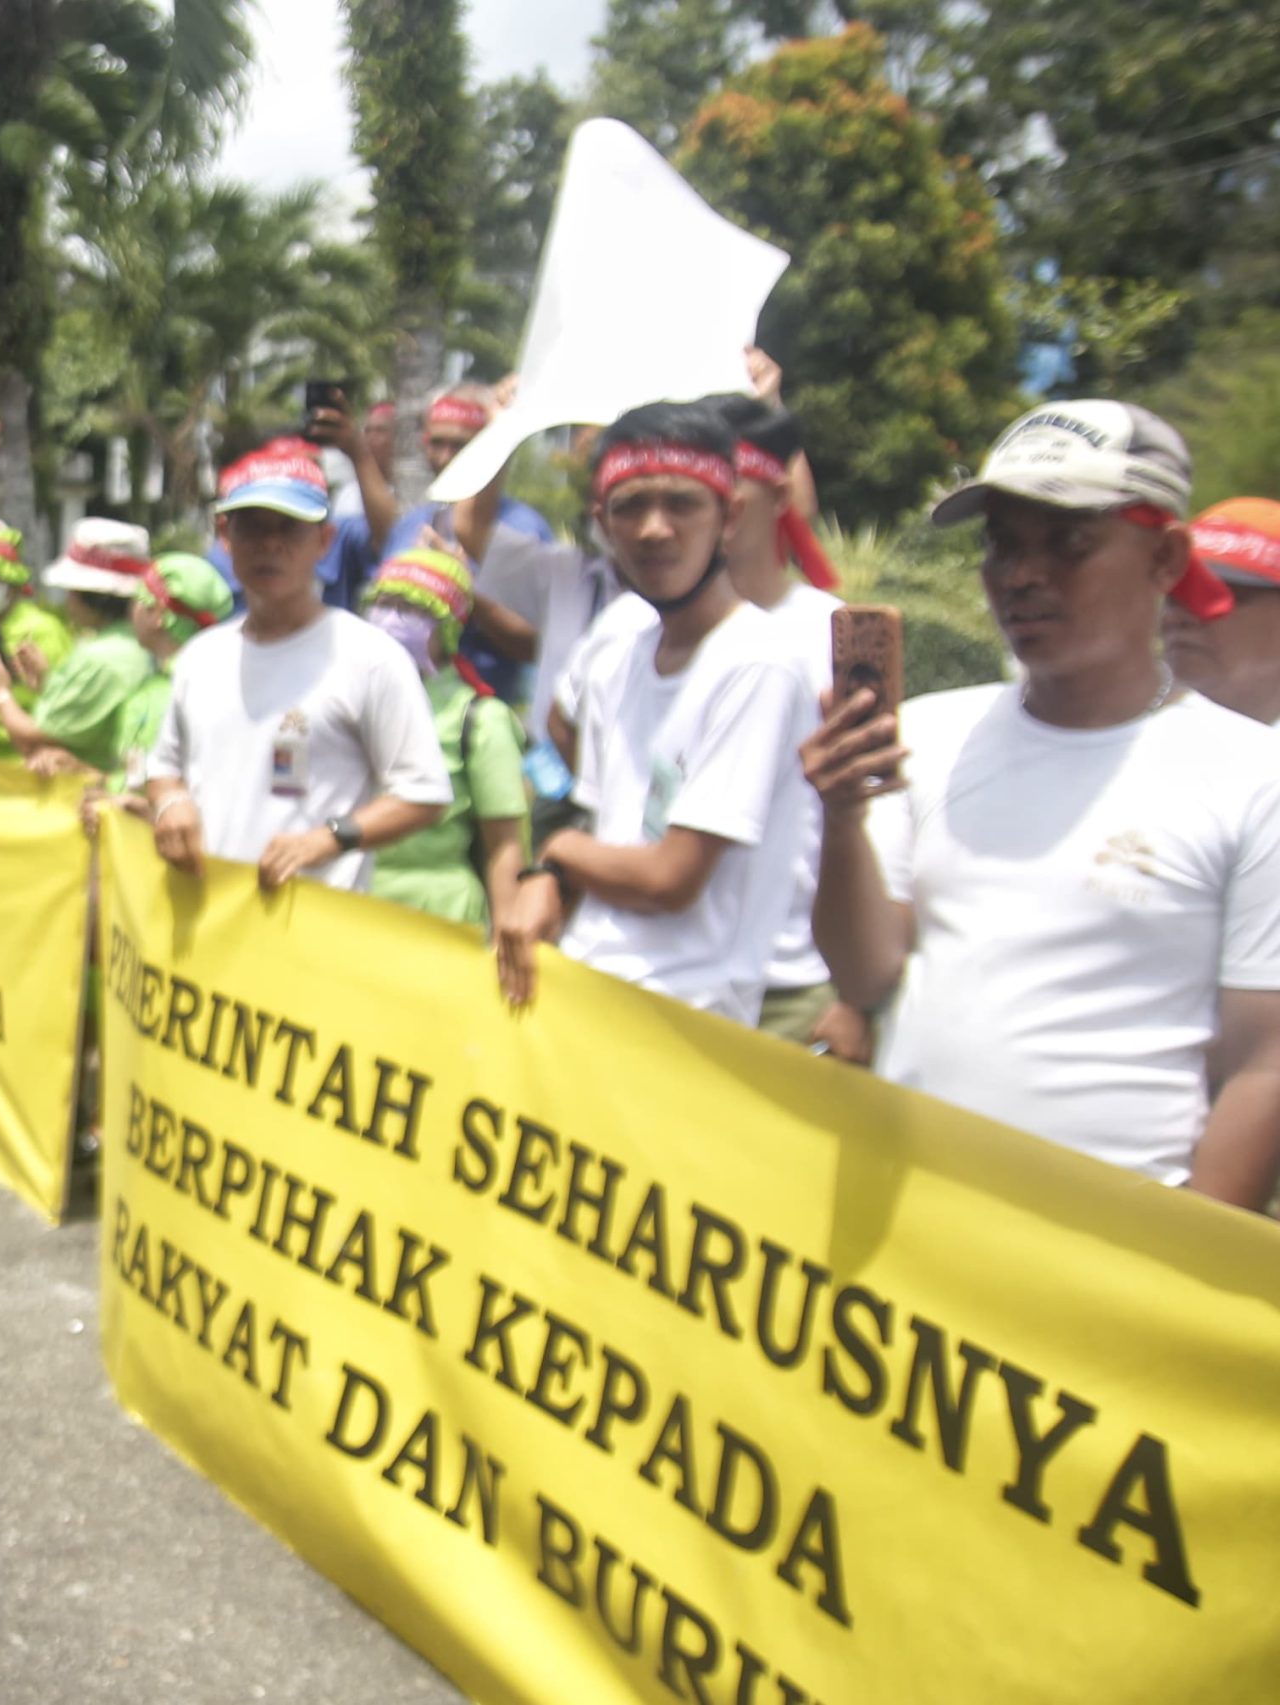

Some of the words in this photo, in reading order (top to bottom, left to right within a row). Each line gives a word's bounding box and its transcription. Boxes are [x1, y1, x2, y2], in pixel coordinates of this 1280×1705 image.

[111, 1194, 309, 1412] RAKYAT
[325, 1362, 506, 1548] DAN
[536, 1491, 826, 1705] BURU
[126, 1080, 451, 1340] BERPIHAK
[464, 1274, 853, 1632] KEPADA
[452, 1097, 1203, 1610] SEHARUSNYA
